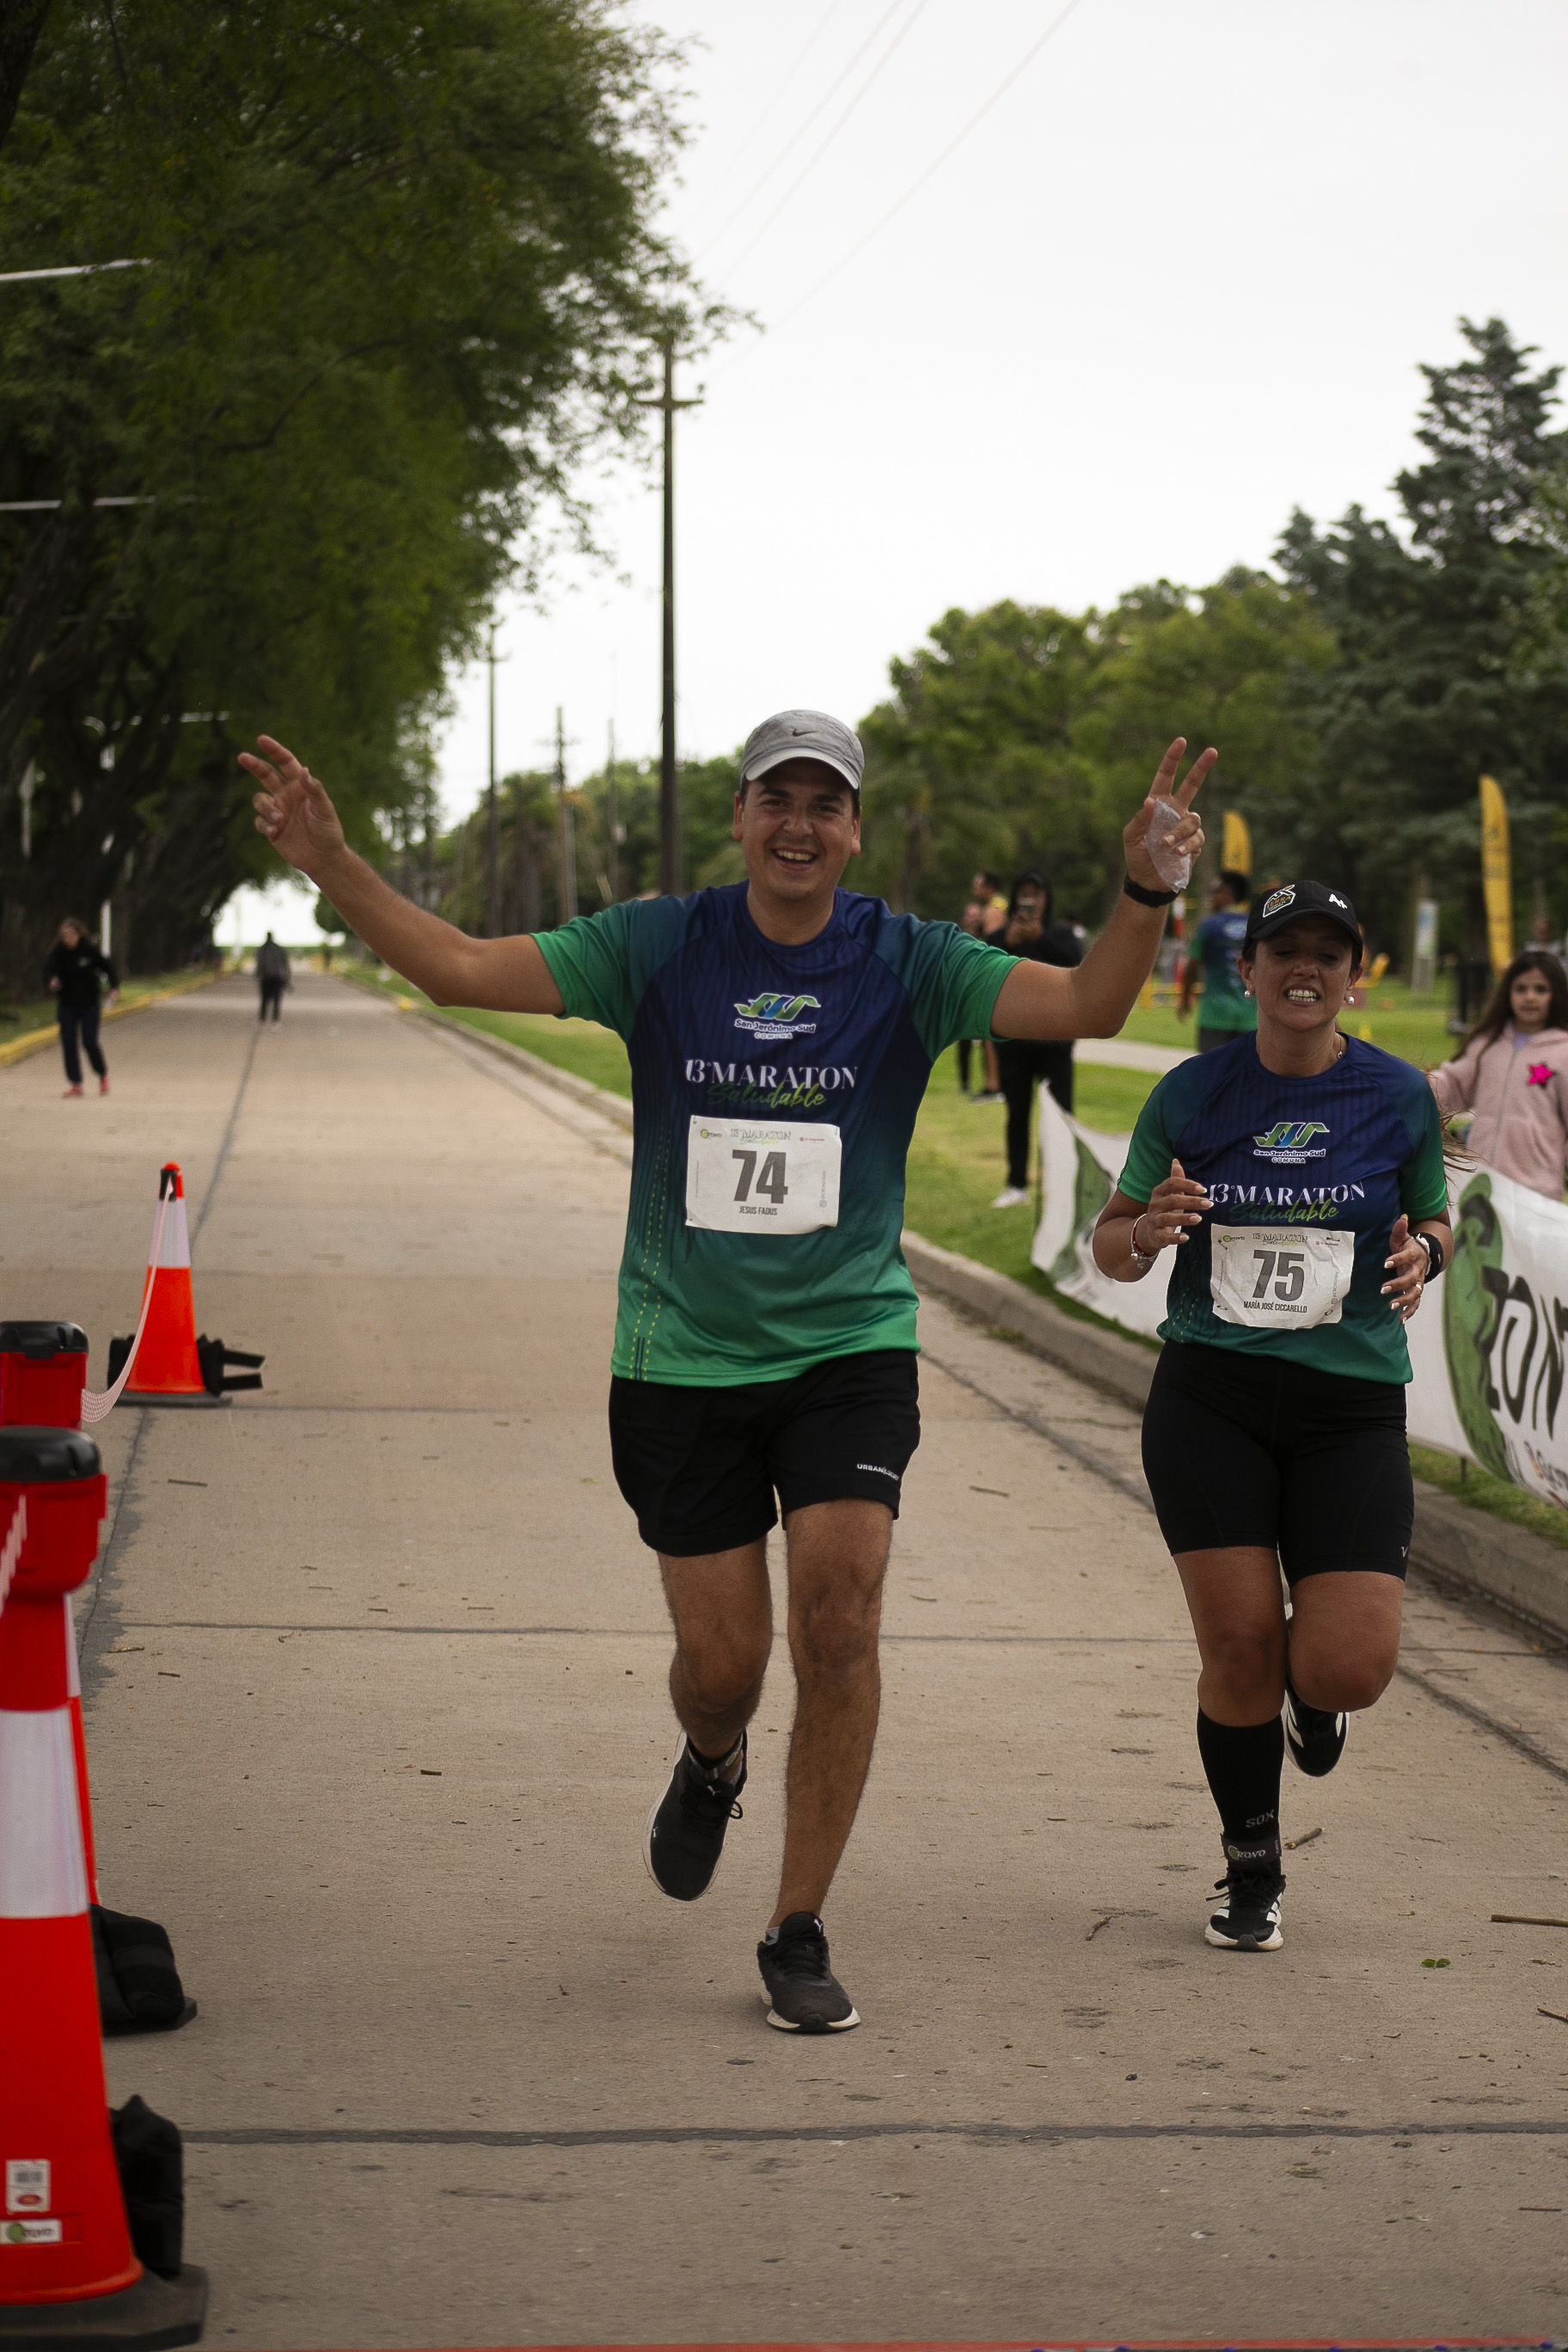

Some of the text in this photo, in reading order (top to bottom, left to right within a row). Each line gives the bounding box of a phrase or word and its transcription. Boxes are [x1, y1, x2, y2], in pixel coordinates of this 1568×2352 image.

[735, 1019, 816, 1033] San Jerónimo Sud
[707, 1081, 826, 1109] Saludable
[740, 1130, 792, 1141] MARATON
[1309, 1148, 1326, 1157] Sud
[732, 1149, 788, 1204] 74
[739, 1205, 757, 1215] JESUS
[1229, 1198, 1339, 1222] Saludable
[1262, 1234, 1308, 1244] MARATON
[1252, 1249, 1305, 1302] 75
[1243, 1301, 1308, 1314] MARÍA JOSÉ CICCARELLO
[1246, 1809, 1274, 1828] SOX
